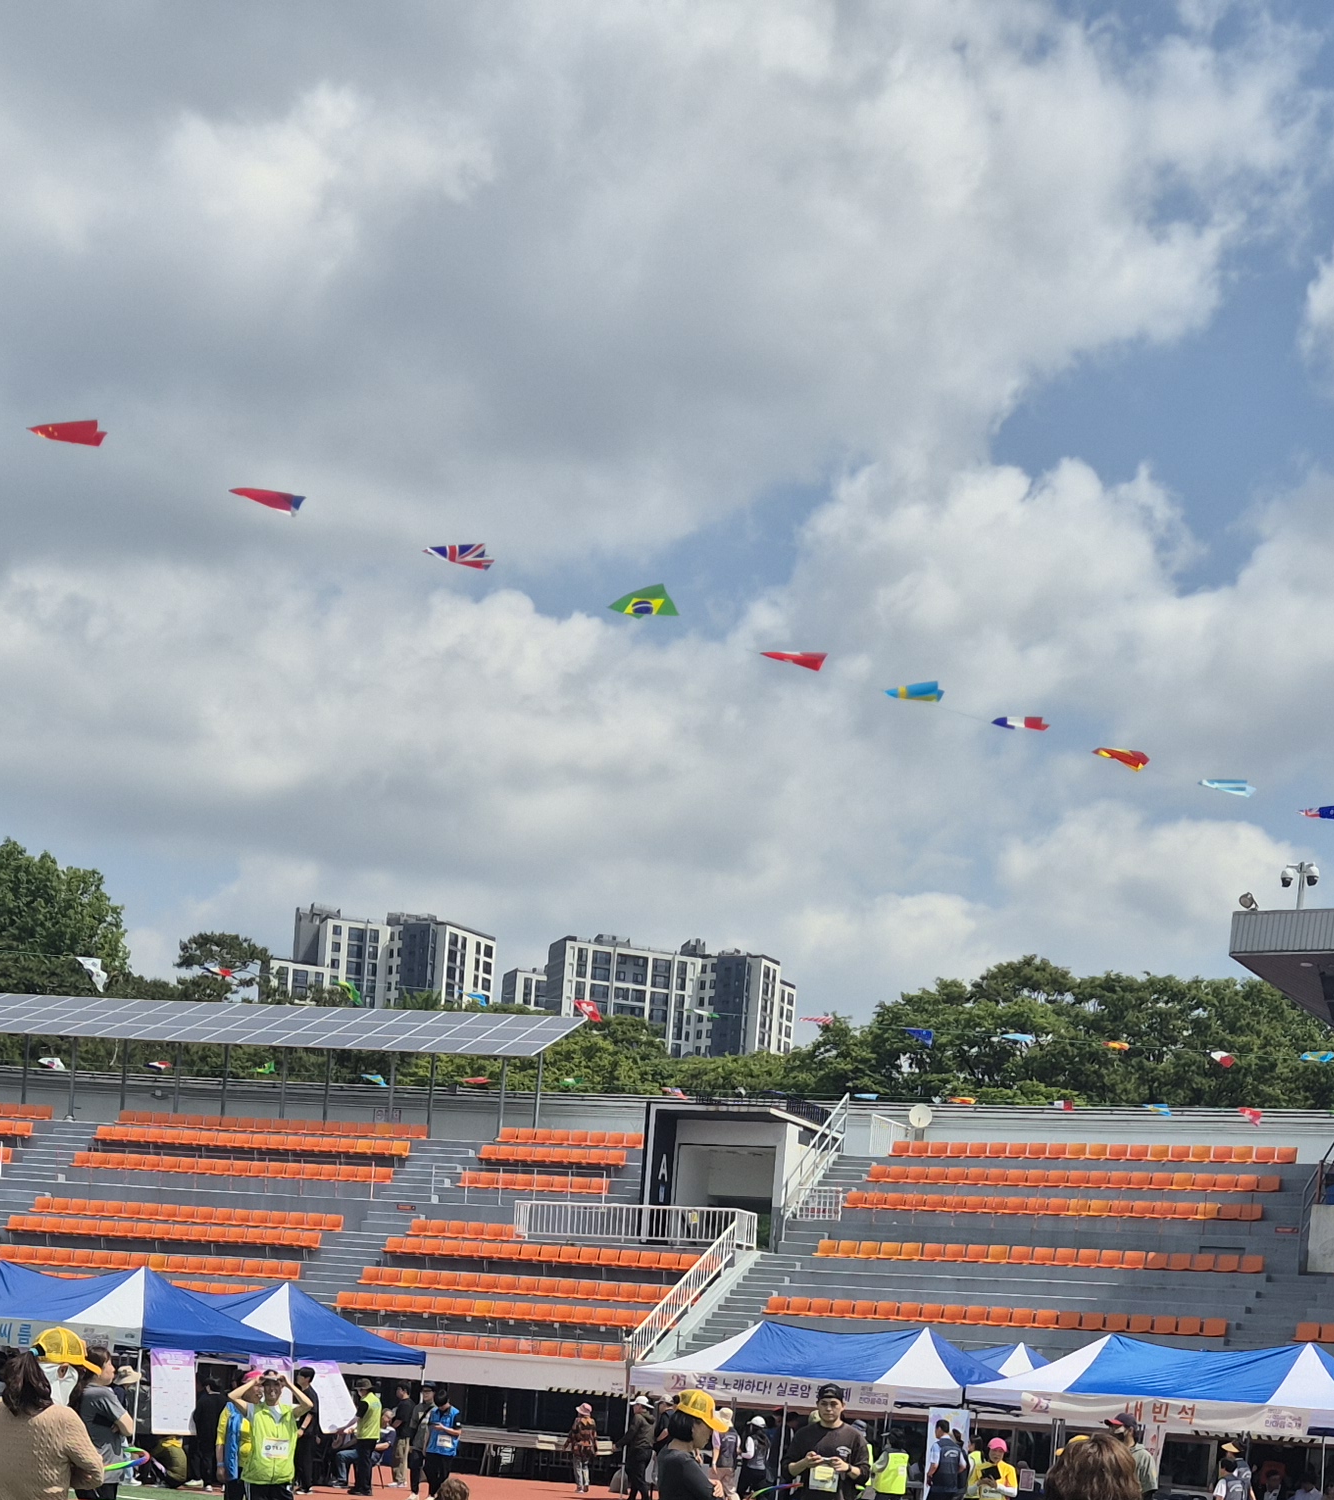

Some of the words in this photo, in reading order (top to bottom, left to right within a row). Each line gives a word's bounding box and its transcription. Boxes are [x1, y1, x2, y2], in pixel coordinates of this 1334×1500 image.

[658, 1154, 668, 1182] A
[720, 1378, 772, 1395] 노래하다!
[776, 1381, 812, 1399] 실로암
